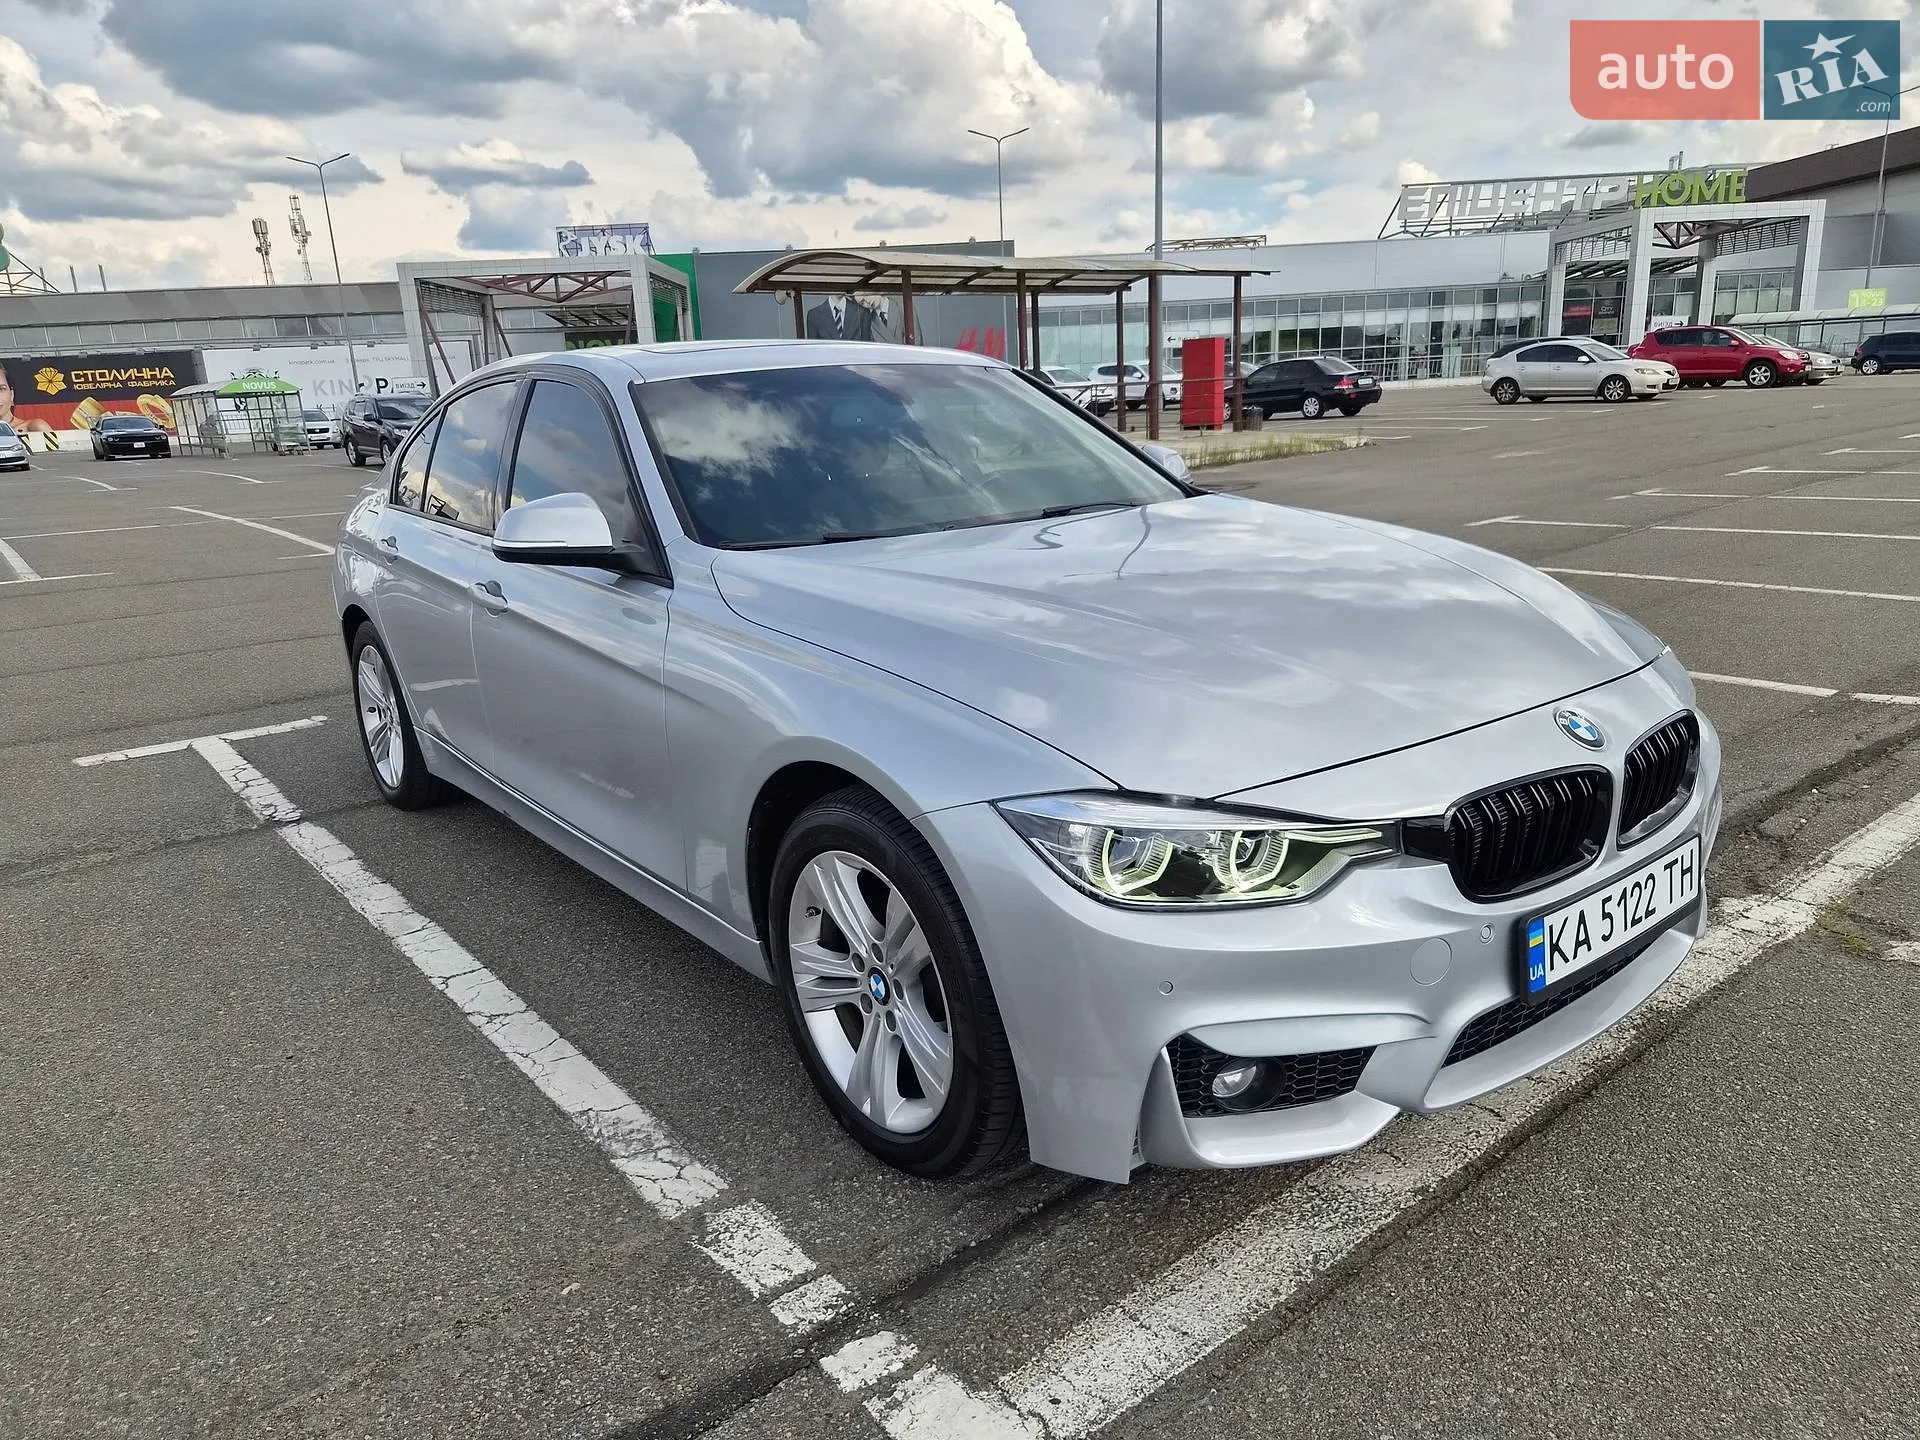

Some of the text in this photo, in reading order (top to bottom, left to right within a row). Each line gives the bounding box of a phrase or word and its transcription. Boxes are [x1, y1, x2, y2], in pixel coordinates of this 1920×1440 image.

[1634, 169, 1749, 209] HOME
[71, 366, 175, 382] СТОЛИЧНА
[73, 382, 123, 390] ЮВЕЛІРНА
[242, 381, 277, 389] NOVUS
[1549, 849, 1694, 971] KA 5122 TH
[1530, 963, 1544, 981] UA
